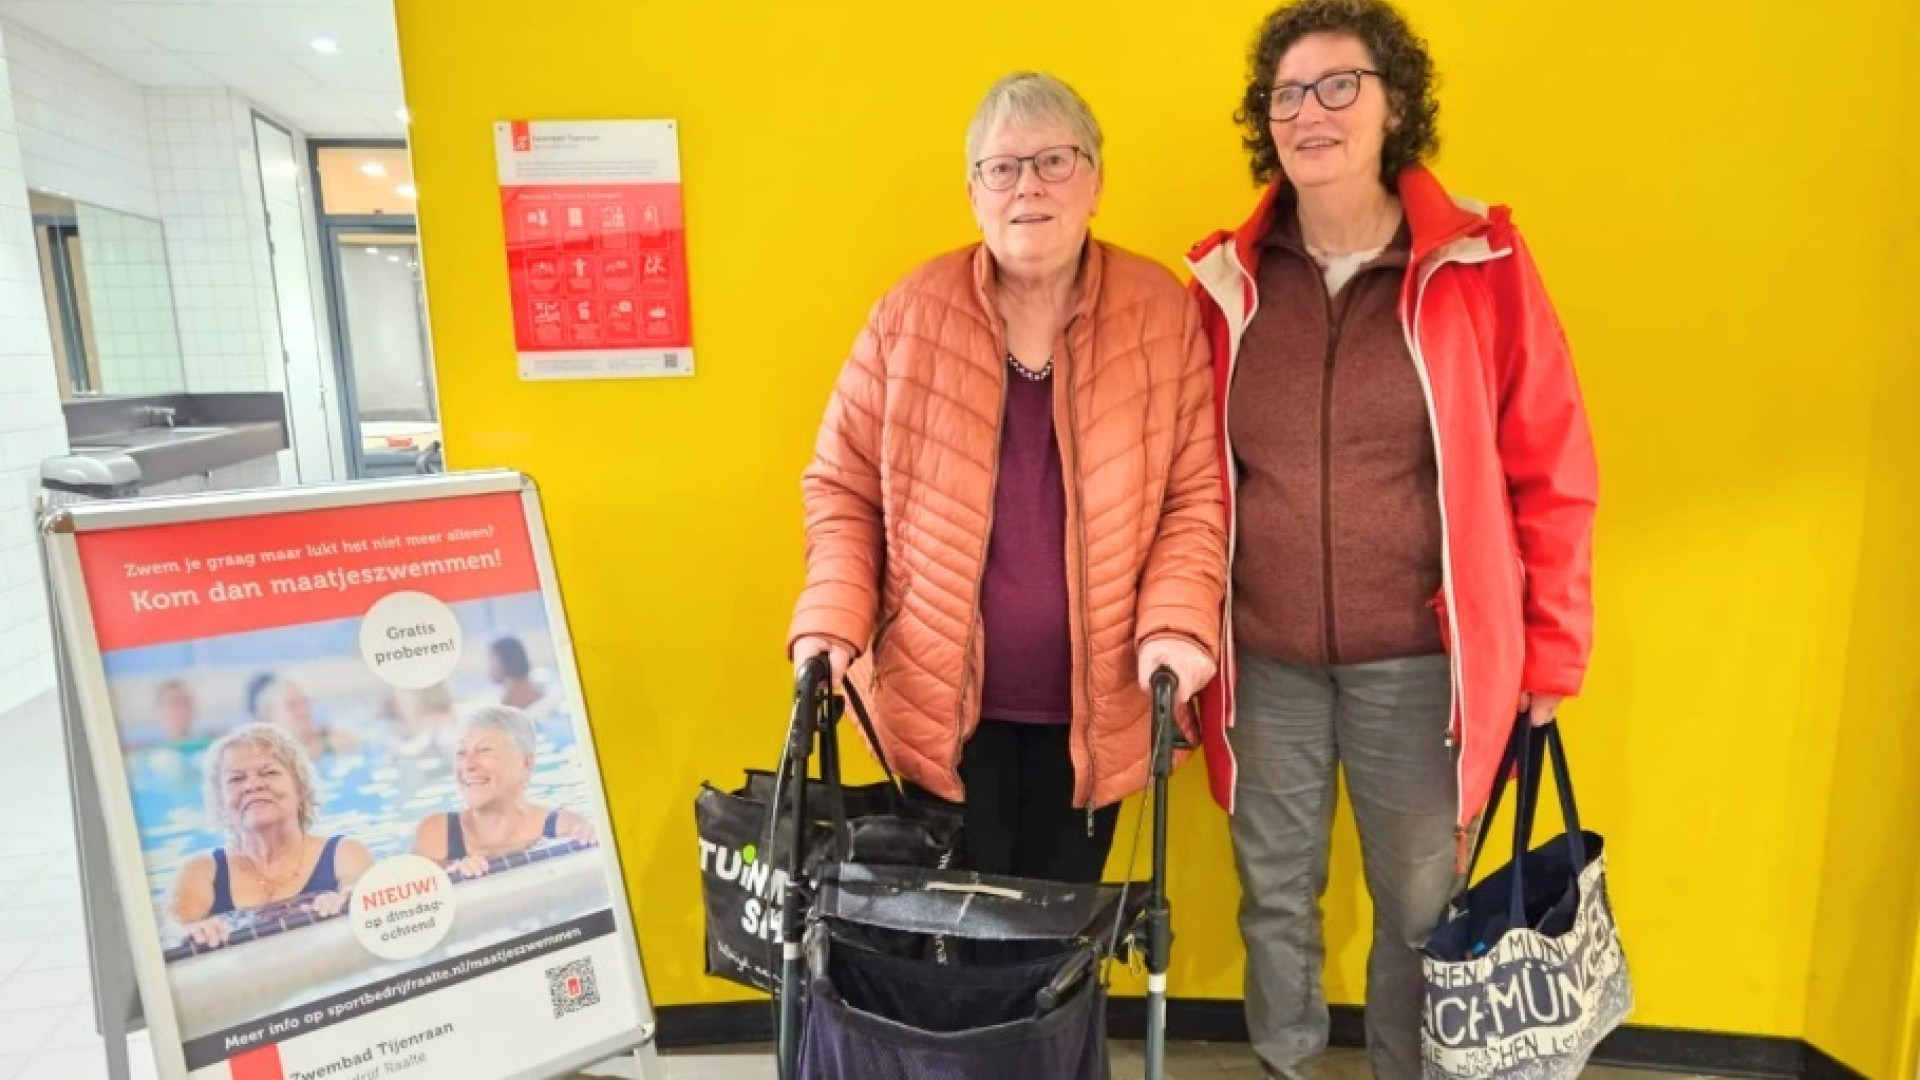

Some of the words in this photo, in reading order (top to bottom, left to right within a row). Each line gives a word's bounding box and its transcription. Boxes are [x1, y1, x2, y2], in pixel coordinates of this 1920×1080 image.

[124, 563, 180, 578] Zwem
[186, 557, 201, 574] je
[207, 552, 256, 572] graag
[260, 548, 302, 563] maar
[306, 543, 338, 557] lukt
[342, 540, 368, 553] het
[372, 535, 401, 549] niet
[406, 531, 442, 546] meer
[130, 588, 200, 612] Kom
[208, 580, 264, 603] dan
[269, 548, 502, 595] maatjeszwemmen!
[386, 622, 436, 640] Gratis
[374, 637, 455, 667] proberen!
[362, 875, 438, 912] NIEUW!
[364, 916, 382, 930] op
[381, 916, 436, 942] ochtend
[225, 1028, 265, 1051] Meer
[268, 1016, 300, 1035] info
[303, 1009, 324, 1025] op
[326, 927, 582, 1017] sportbedrijfraalte.nl/maatjeszwemmen
[376, 1021, 455, 1055] Tijenraan
[384, 1051, 427, 1073] Raalte
